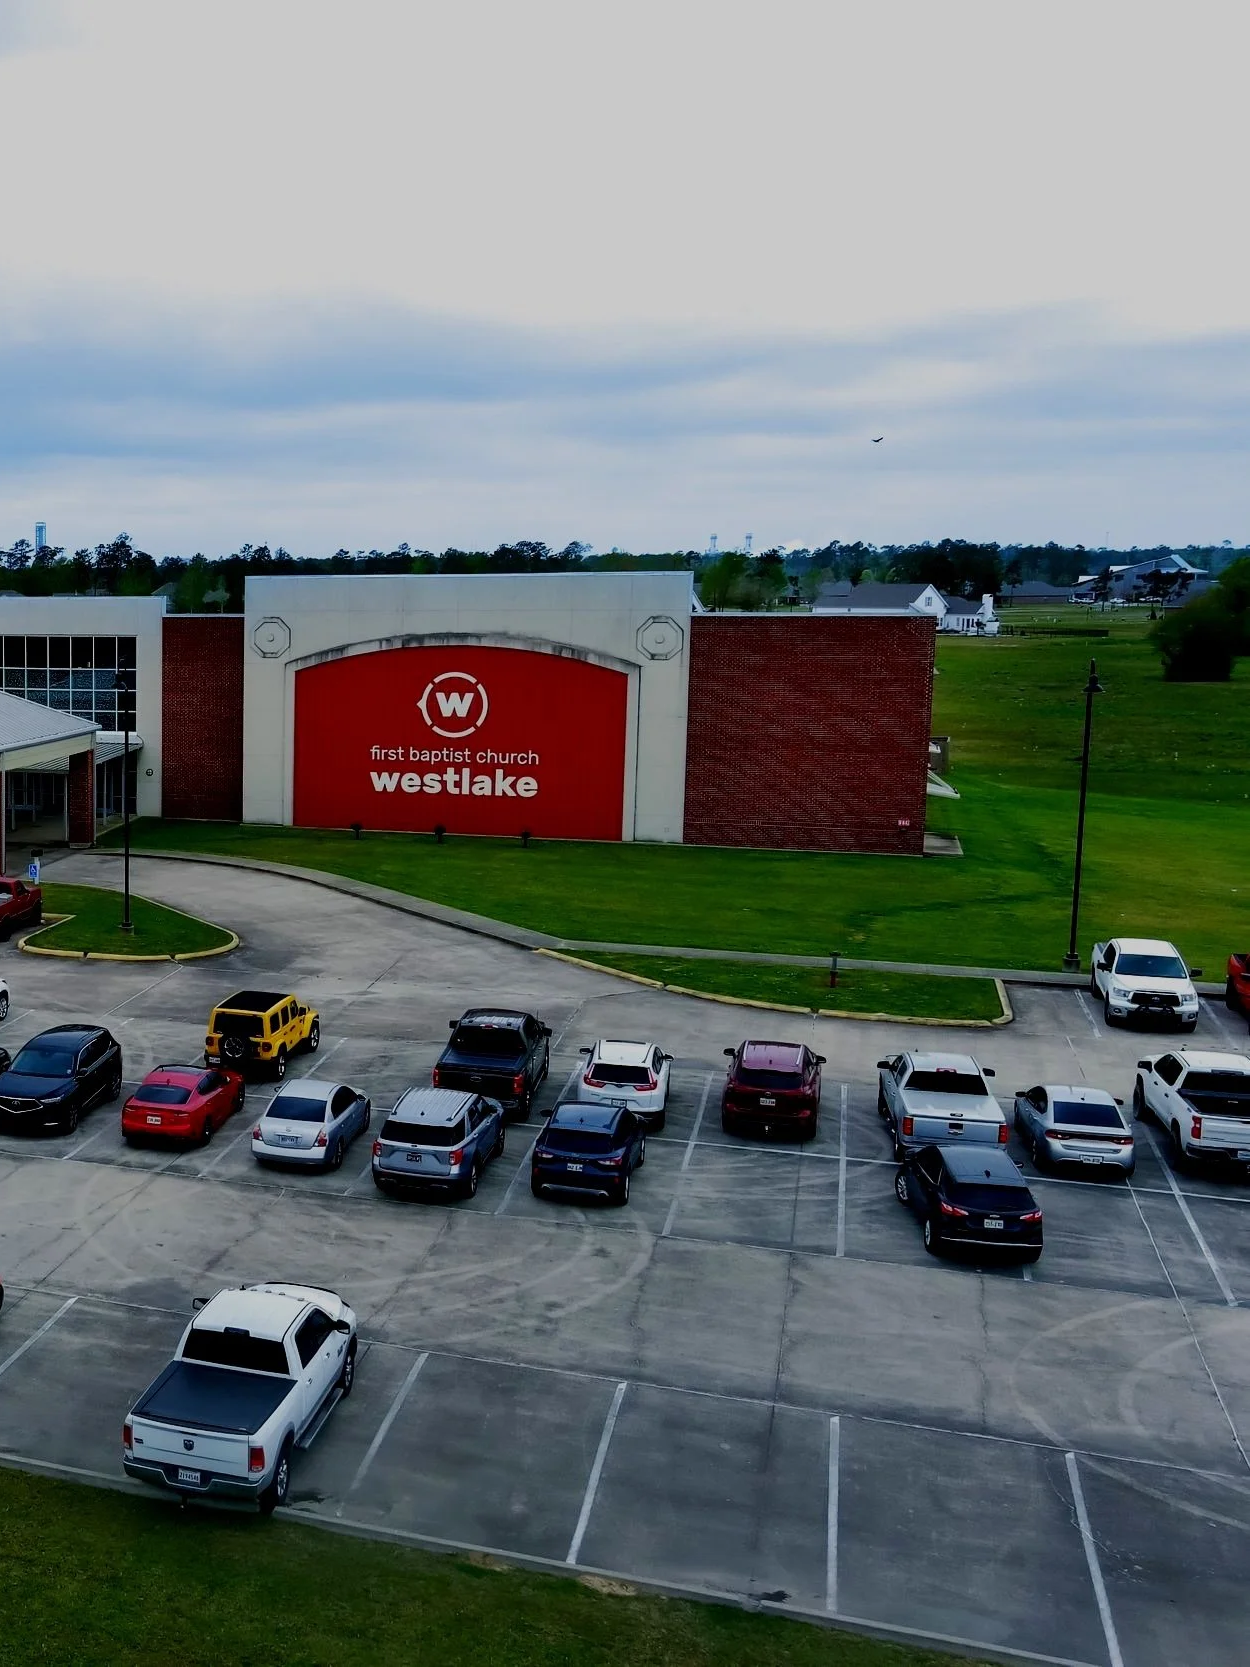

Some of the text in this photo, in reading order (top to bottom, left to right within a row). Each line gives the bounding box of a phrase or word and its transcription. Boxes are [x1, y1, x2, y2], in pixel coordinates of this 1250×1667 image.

[370, 745, 539, 765] first baptist church
[370, 767, 539, 797] westlake
